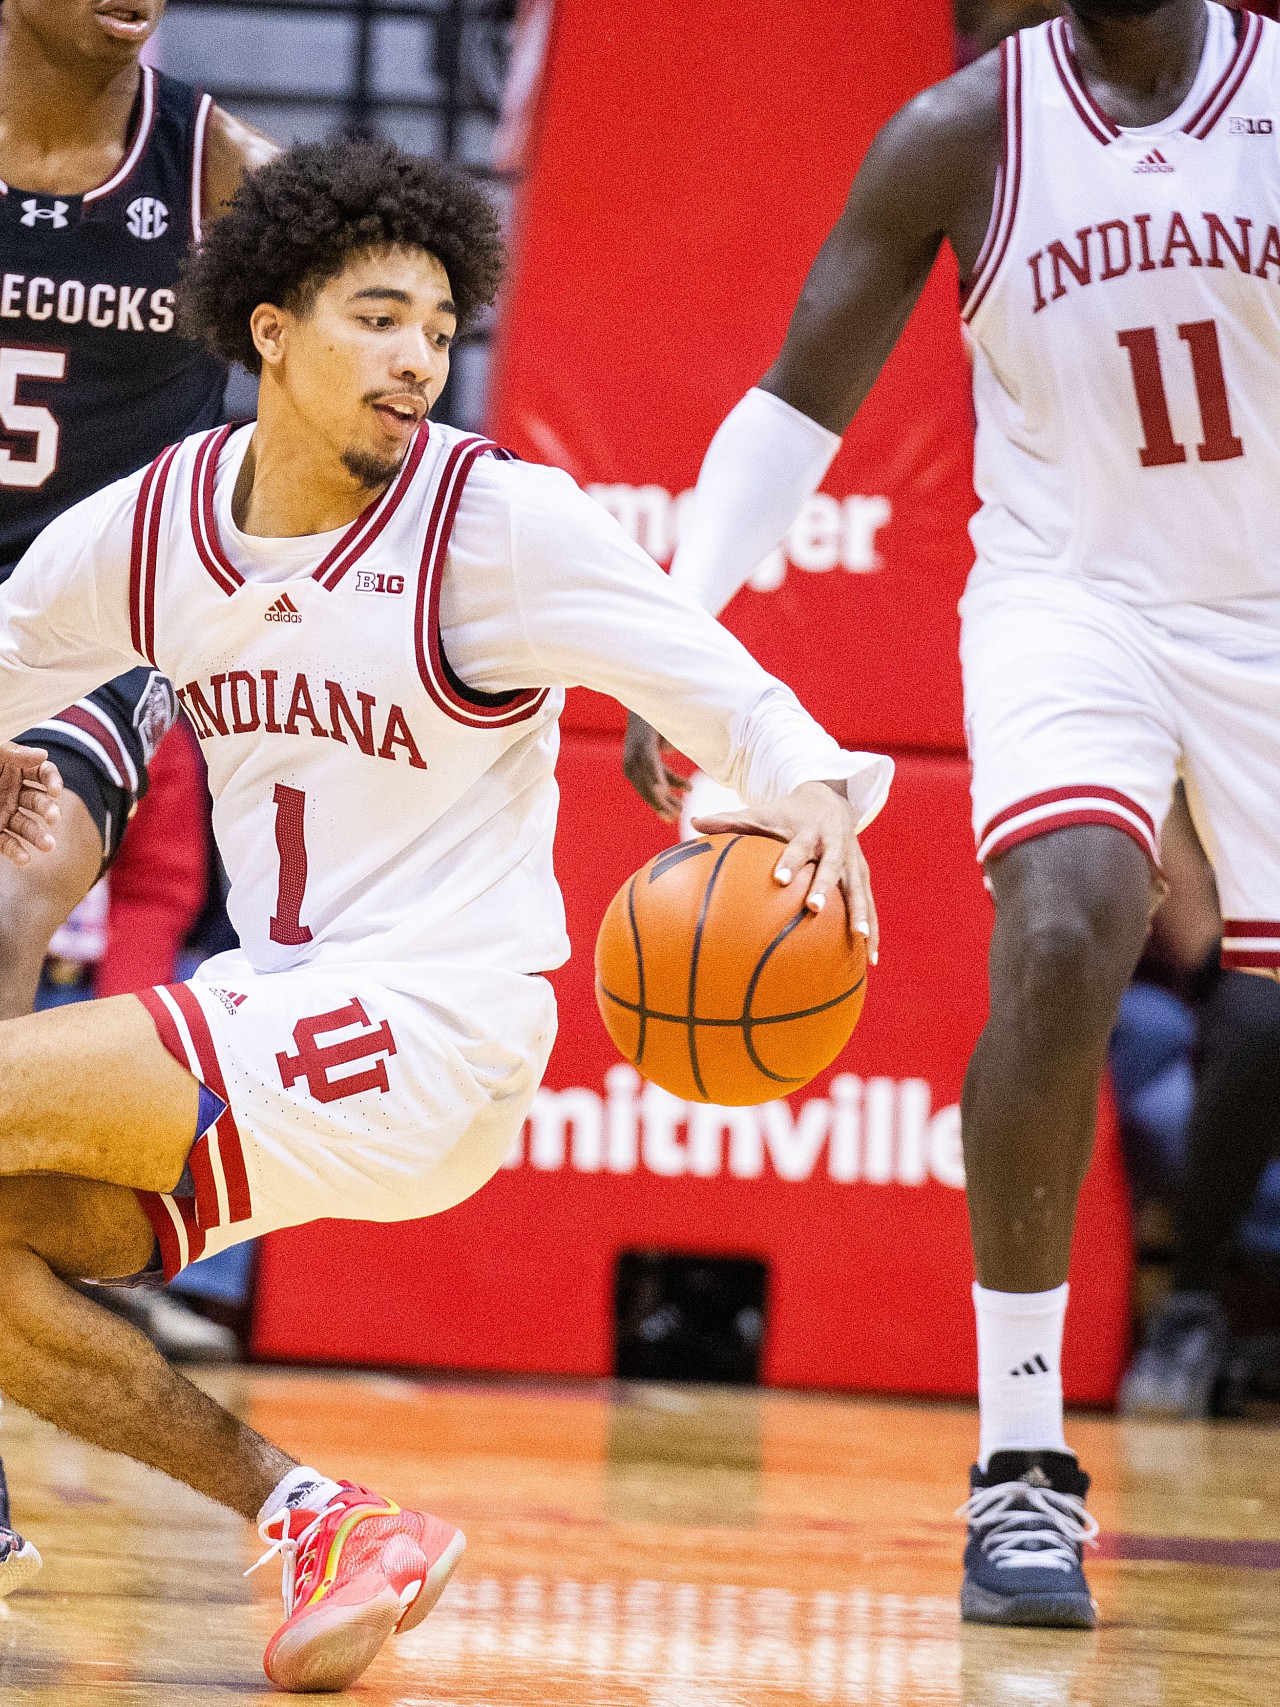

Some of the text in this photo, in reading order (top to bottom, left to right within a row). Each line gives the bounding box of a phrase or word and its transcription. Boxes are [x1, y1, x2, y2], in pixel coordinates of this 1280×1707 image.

[125, 197, 169, 240] SEC
[1132, 163, 1174, 174] adidas
[1027, 211, 1280, 314] INDIANA
[1116, 319, 1244, 467] 11
[264, 610, 302, 623] adidas
[175, 669, 427, 770] INDIANA
[269, 782, 313, 946] 1
[502, 1063, 966, 1190] mithville
